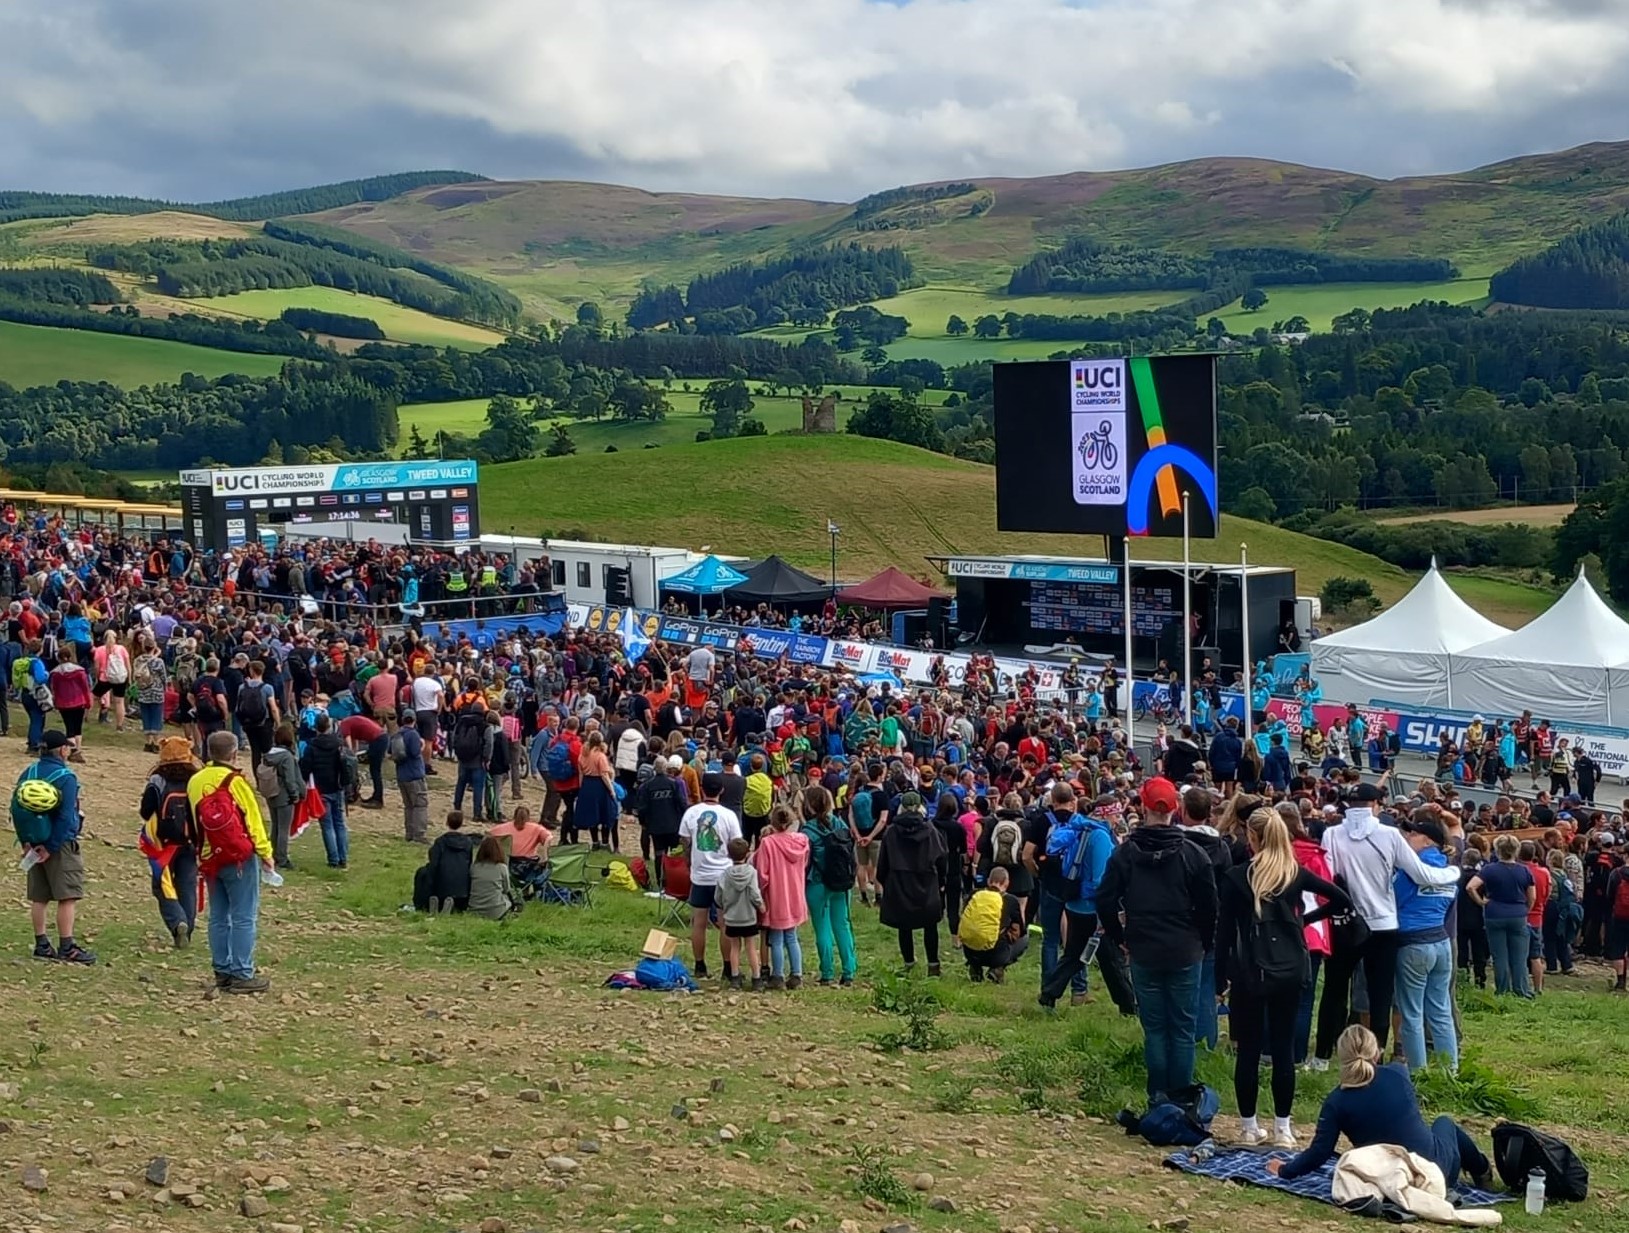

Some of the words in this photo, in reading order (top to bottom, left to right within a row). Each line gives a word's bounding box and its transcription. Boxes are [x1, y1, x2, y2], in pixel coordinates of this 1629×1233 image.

[1084, 366, 1120, 389] UCI
[262, 473, 294, 483] CYCLING
[296, 472, 325, 481] WORLD
[407, 468, 439, 482] TWEED
[440, 467, 473, 481] VALLEY
[1079, 474, 1121, 484] GLASGOW
[226, 475, 260, 491] UCI
[262, 479, 326, 490] CHAMPIONSHIPS
[1079, 485, 1121, 495] SCOTLAND
[955, 561, 973, 574] UCI
[664, 620, 699, 633] GoPro
[703, 627, 739, 639] GoPro
[832, 643, 864, 662] BigMat
[878, 650, 911, 667] BigMat
[1590, 742, 1606, 751] THE
[1588, 750, 1628, 763] NATIONAL
